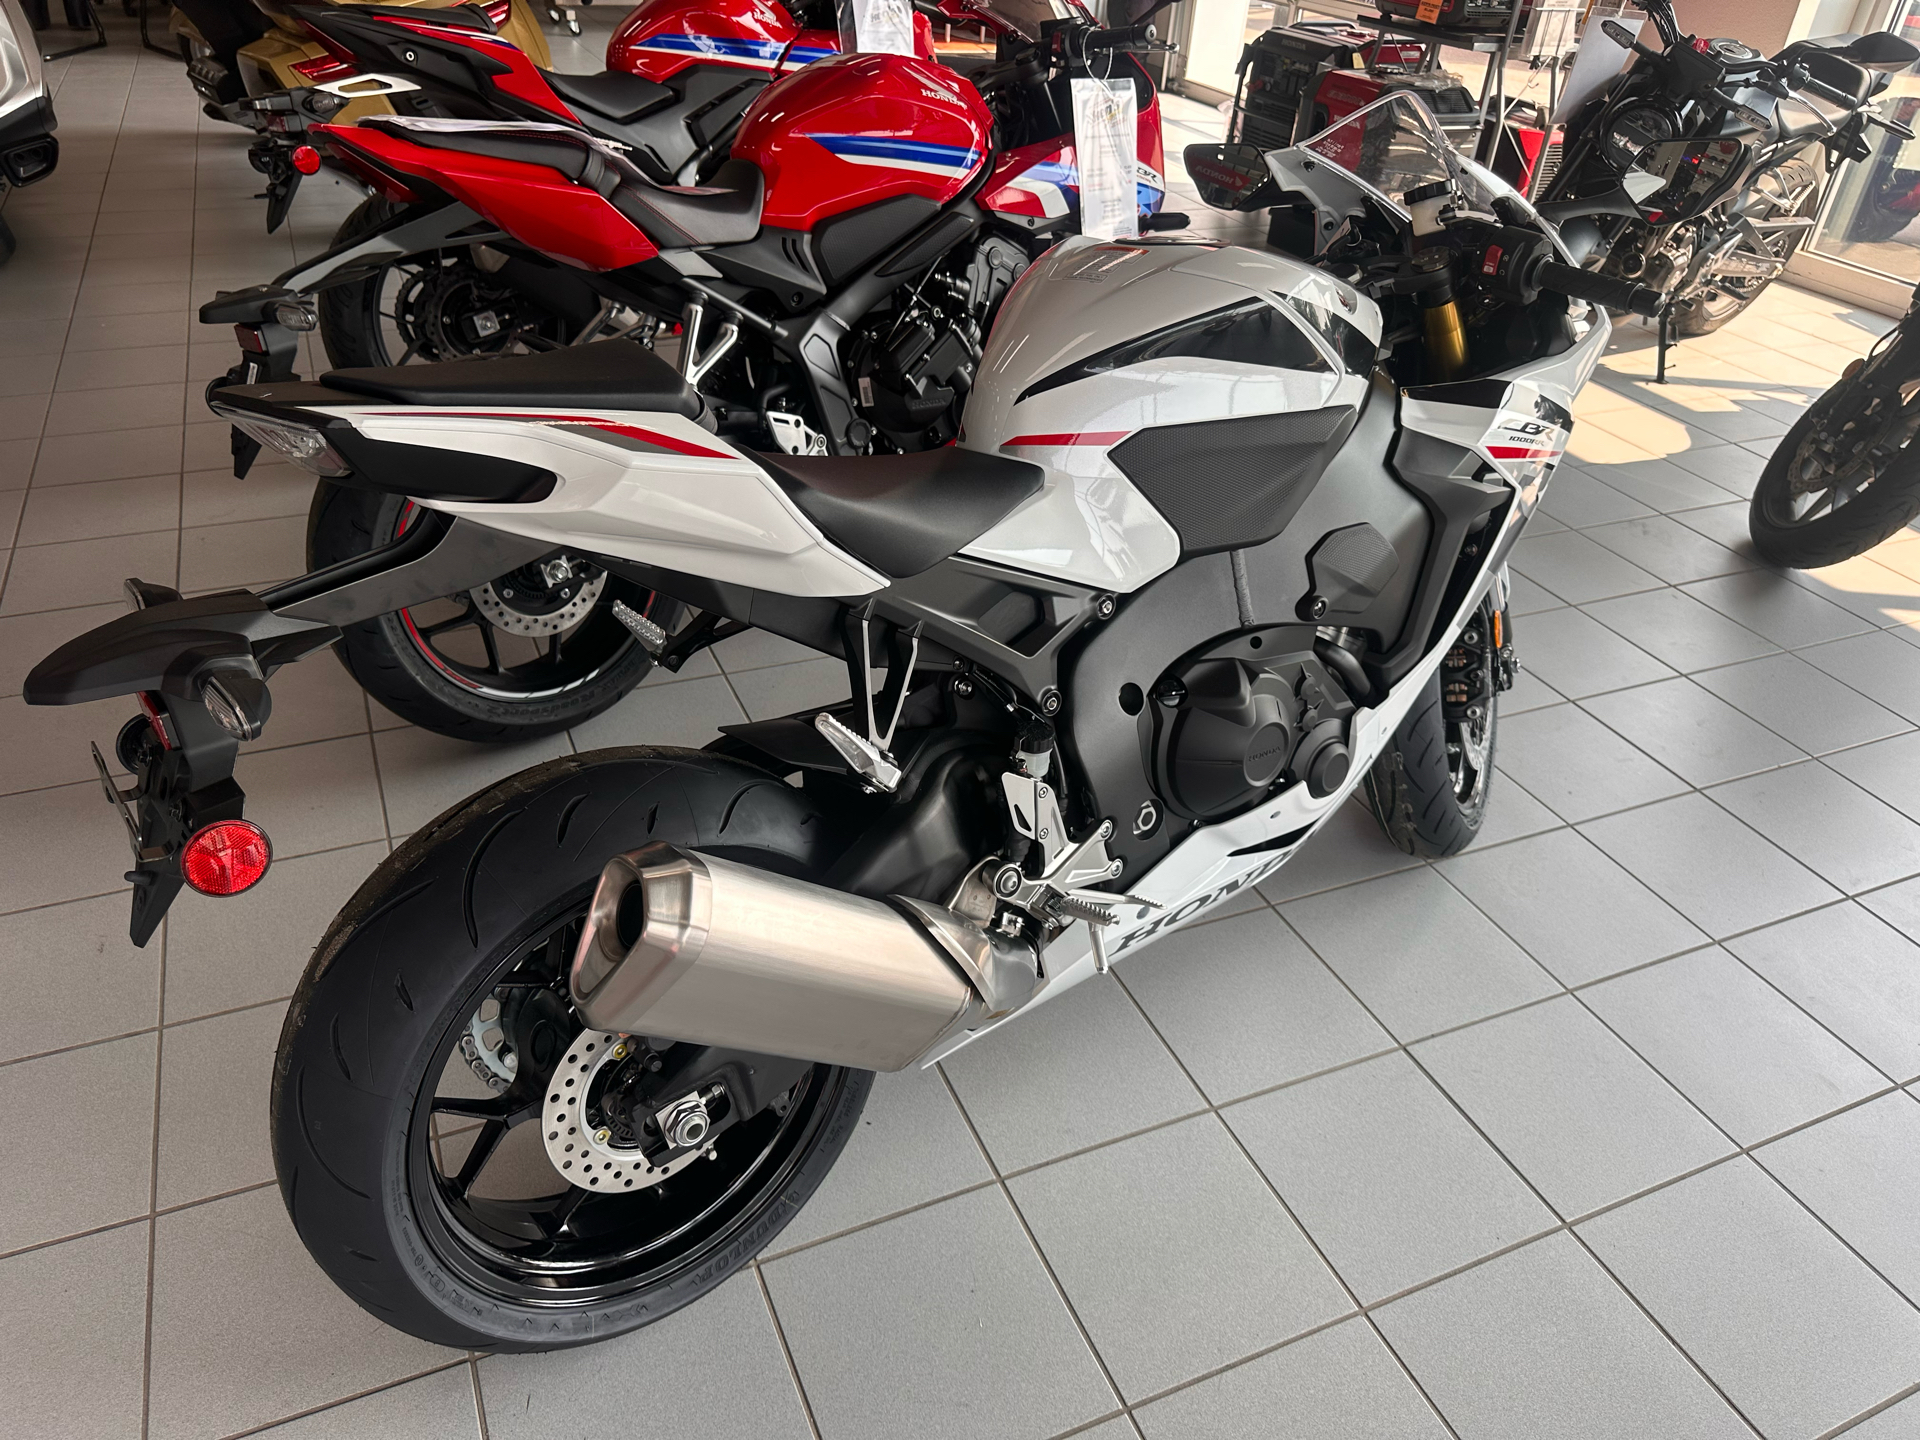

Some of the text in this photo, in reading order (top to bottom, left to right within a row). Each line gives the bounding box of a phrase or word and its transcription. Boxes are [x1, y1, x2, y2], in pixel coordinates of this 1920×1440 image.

[921, 89, 967, 110] HONDA
[1498, 419, 1555, 441] CBR
[1248, 745, 1281, 762] HONDA
[697, 1205, 783, 1284] DUNLOP
